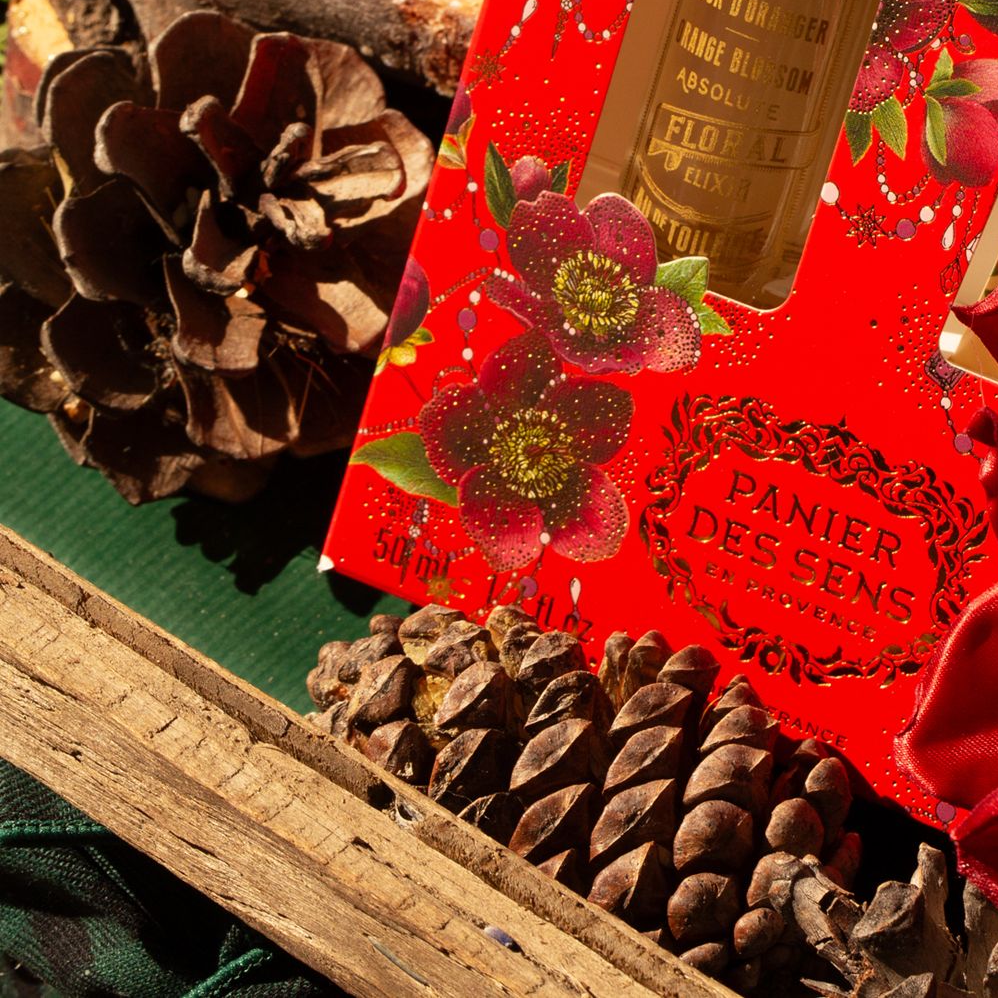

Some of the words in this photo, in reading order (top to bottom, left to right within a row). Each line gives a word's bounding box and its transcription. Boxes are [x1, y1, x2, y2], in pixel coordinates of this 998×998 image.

[676, 19, 726, 67] ORANGE
[729, 47, 813, 95] BLOSSOM
[677, 66, 780, 121] ABSOLUE
[664, 114, 786, 164] FLORAL
[684, 166, 751, 203] ELIXIR
[725, 470, 901, 569] PANIER
[373, 527, 408, 568] 50
[416, 550, 450, 582] ml
[687, 505, 781, 570] DES
[789, 549, 915, 624] SENS
[705, 562, 735, 585] EN
[746, 579, 877, 642] PROVENCE
